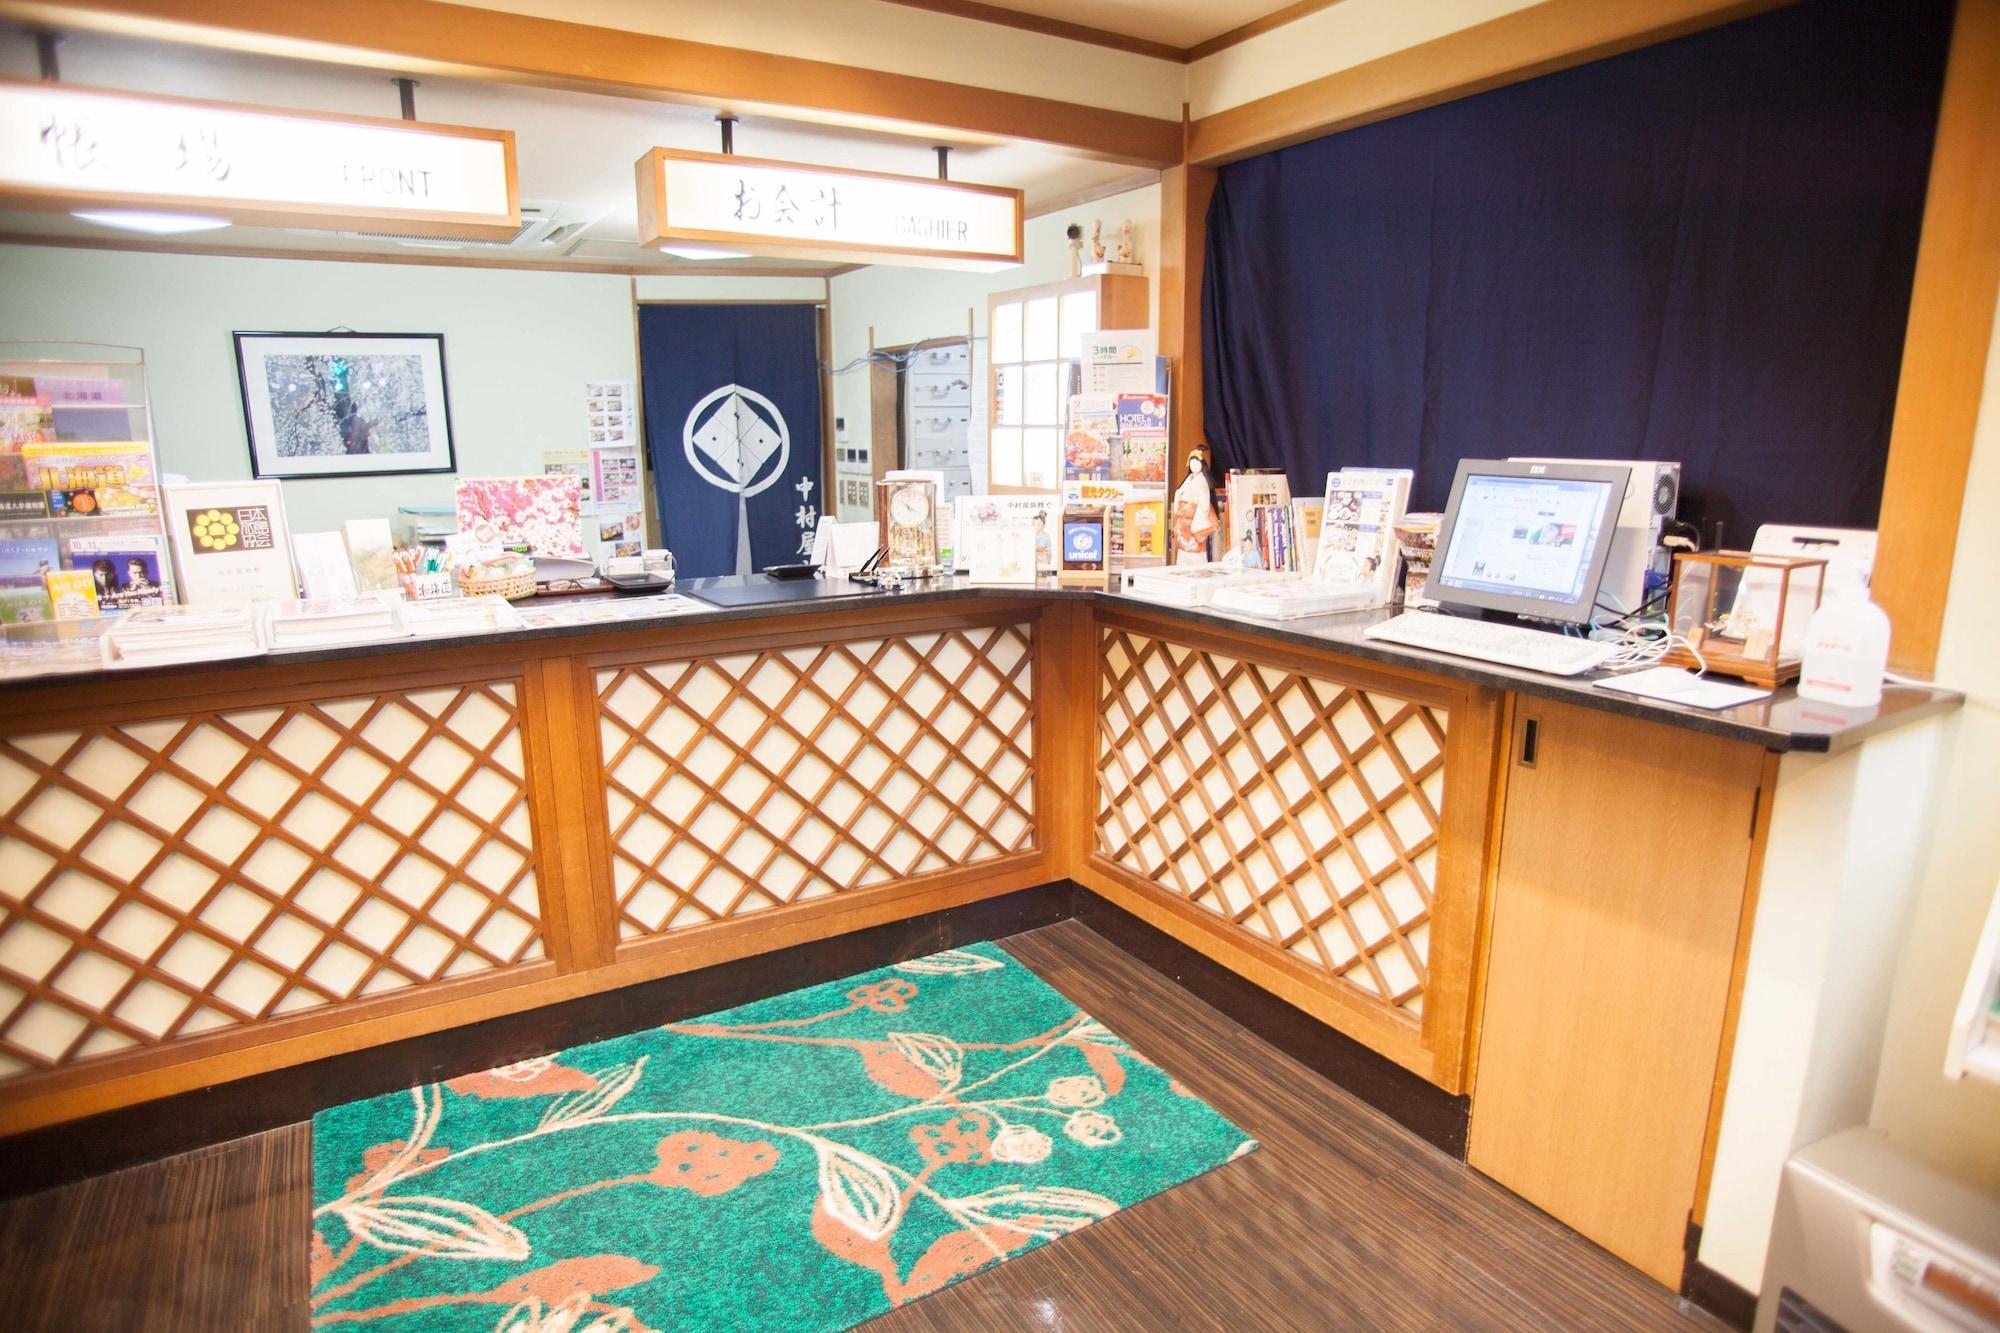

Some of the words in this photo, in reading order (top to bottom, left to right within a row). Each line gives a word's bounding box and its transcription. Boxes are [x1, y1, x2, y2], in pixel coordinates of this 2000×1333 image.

[342, 164, 432, 198] FRONT
[734, 179, 842, 232] お会計
[894, 215, 968, 242] CASHIER
[1092, 345, 1117, 355] 3時間
[1120, 414, 1146, 423] HOTEL
[33, 466, 125, 489] 北海道
[795, 476, 817, 565] 中村屋
[1068, 550, 1098, 560] unicef
